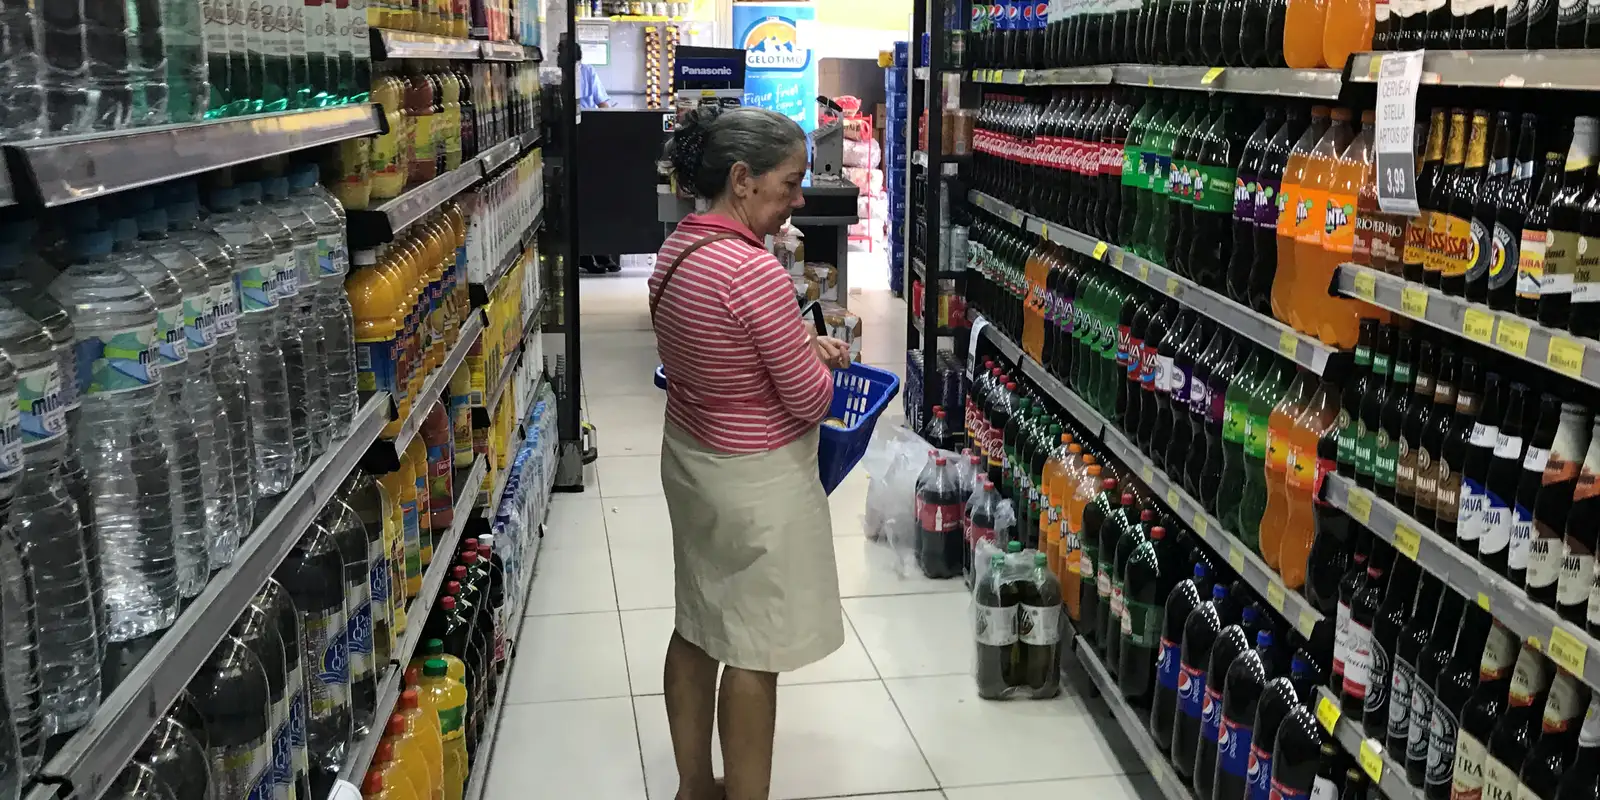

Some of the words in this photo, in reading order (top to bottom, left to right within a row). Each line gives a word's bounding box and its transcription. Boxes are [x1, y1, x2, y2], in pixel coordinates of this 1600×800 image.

[747, 55, 803, 64] GELOTIMO
[681, 66, 732, 75] Panasonic
[1382, 79, 1411, 98] CERVEJA
[1383, 103, 1406, 121] STELLA
[1386, 167, 1406, 198] 3,99
[1326, 207, 1348, 226] NTA
